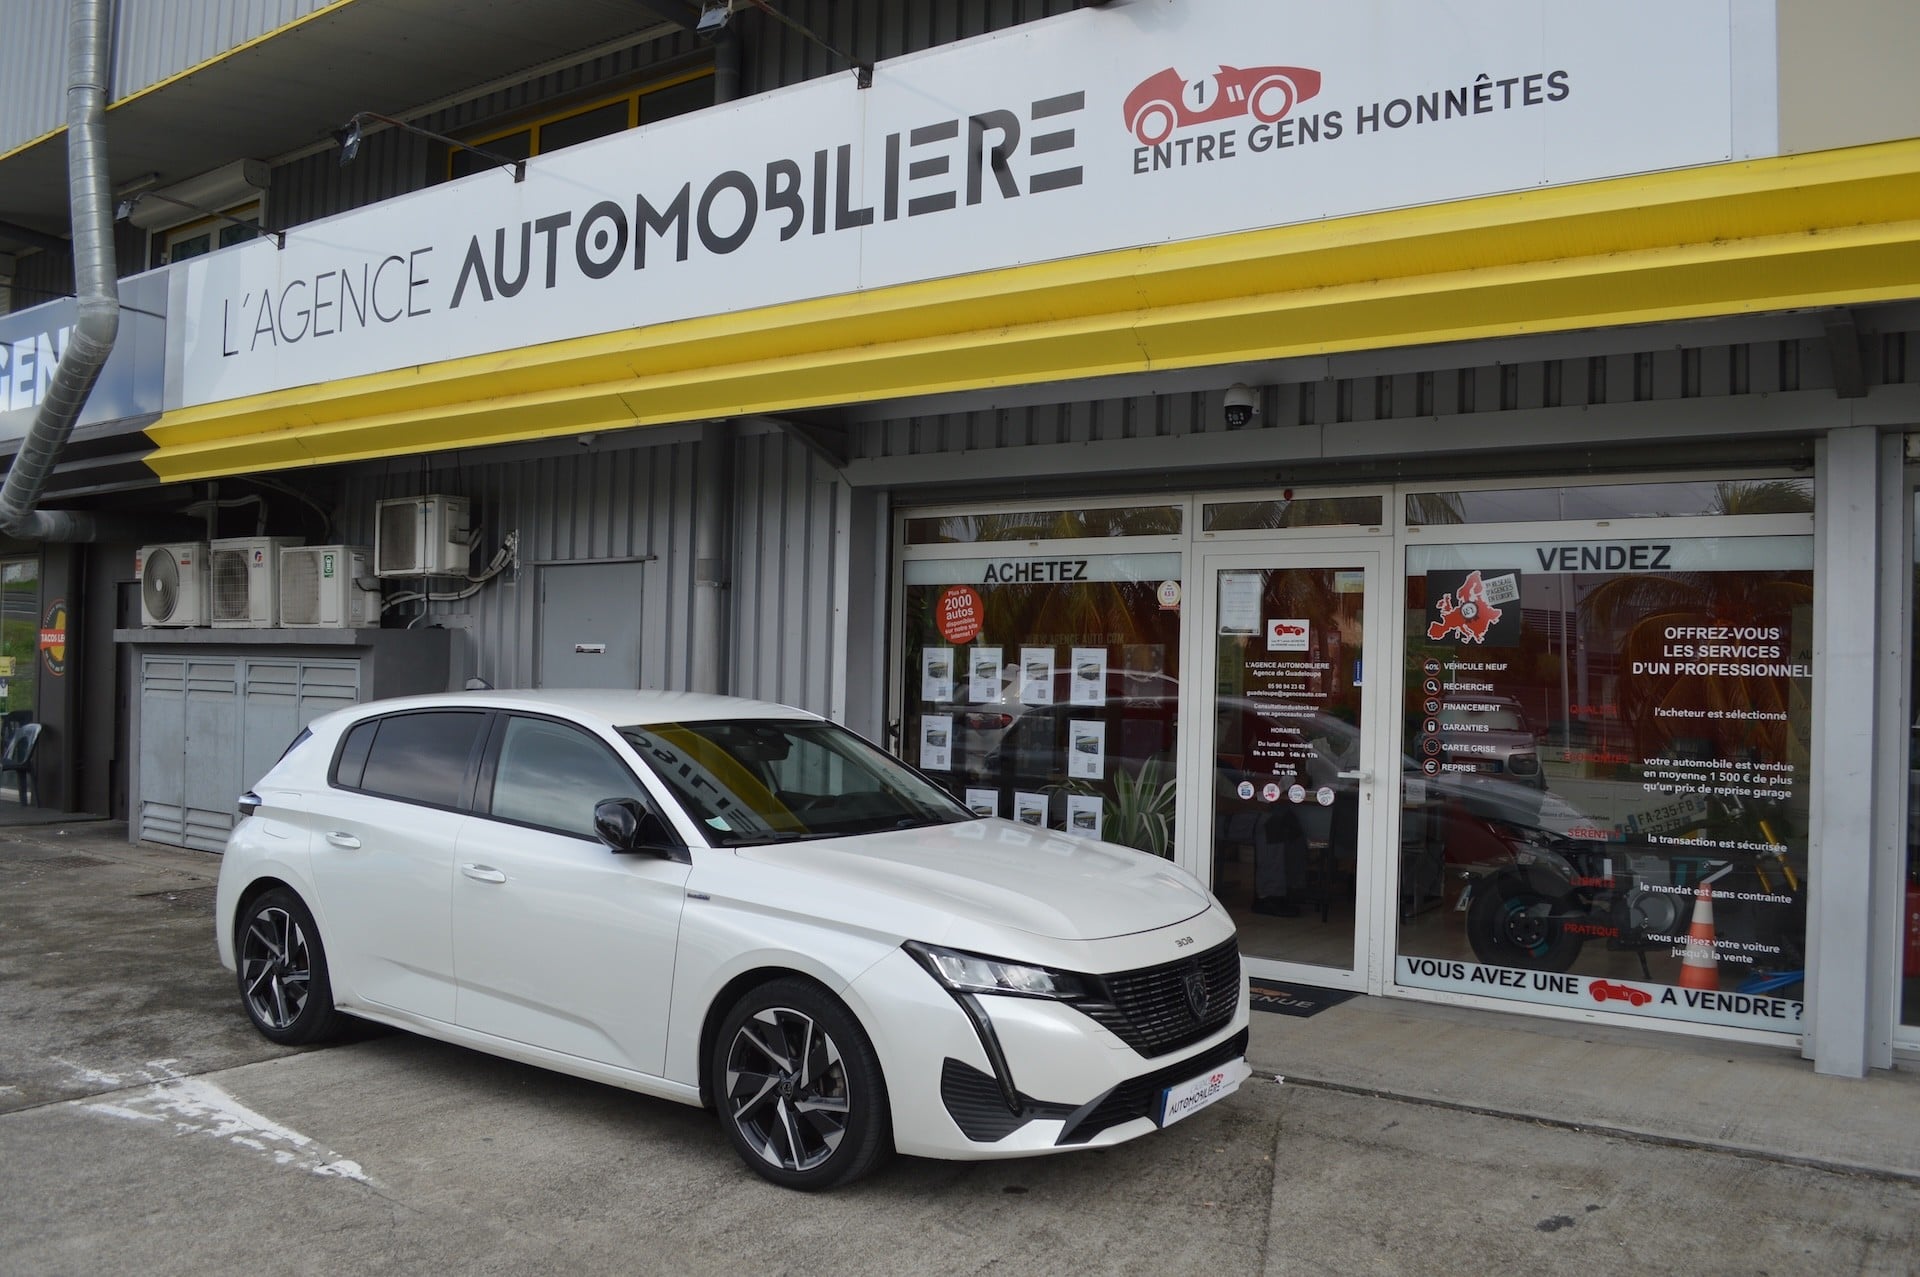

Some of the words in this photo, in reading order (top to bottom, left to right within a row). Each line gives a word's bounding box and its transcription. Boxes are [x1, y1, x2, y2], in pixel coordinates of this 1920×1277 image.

[1193, 80, 1205, 104] 1
[1133, 129, 1236, 174] ENTRE
[1248, 111, 1343, 153] GENS
[1357, 70, 1570, 135] HONNÊTES
[223, 246, 433, 357] L'AGENCE
[449, 90, 1086, 309] AUTOMOBILIERE
[1537, 545, 1671, 571] VENDEZ
[984, 560, 1087, 582] ACHETEZ
[944, 594, 972, 611] 2000
[946, 608, 974, 620] autos
[1664, 627, 1780, 640] OFFREZ-VOUS
[1664, 645, 1694, 658] LES
[1697, 646, 1780, 658] SERVICES
[1278, 662, 1330, 670] AUTOMOBILIERE
[1285, 670, 1322, 678] Guadeloupe
[1632, 662, 1670, 675] D'UN
[1674, 663, 1812, 678] PROFESSIONNEL
[1443, 682, 1494, 692] RECHERCHE
[1442, 703, 1501, 712] FINANCEMENT
[1654, 707, 1704, 720] l'acheteur
[1707, 709, 1724, 720] est
[1726, 708, 1788, 721] sélectionné
[1442, 723, 1490, 732] GARANTIES
[1442, 744, 1469, 752] CARTE
[1471, 744, 1496, 752] GRISE
[1442, 764, 1476, 772] REPRISE
[1643, 758, 1669, 767] votre
[1672, 758, 1733, 770] automobile
[1735, 761, 1752, 771] est
[1753, 760, 1794, 772] vendue
[1644, 770, 1656, 778] en
[1659, 771, 1706, 784] moyenne
[1710, 772, 1716, 782] 1
[1719, 773, 1740, 783] 500
[1743, 774, 1751, 784] €
[1752, 774, 1767, 784] de
[1770, 775, 1793, 788] plus
[1643, 782, 1672, 794] qu'un
[1674, 782, 1696, 796] prix
[1698, 784, 1712, 794] de
[1714, 784, 1750, 798] reprise
[1753, 786, 1792, 800] garage
[1648, 833, 1658, 843] la
[1660, 836, 1716, 848] transaction
[1719, 840, 1735, 848] est
[1737, 839, 1788, 852] sécurisée
[1640, 882, 1650, 892] le
[1652, 884, 1691, 896] mandat
[1694, 886, 1710, 896] est
[1712, 888, 1735, 898] sans
[1737, 889, 1792, 904] contrainte
[1564, 922, 1620, 938] PRATIQUE
[1174, 936, 1194, 948] 308
[1648, 933, 1672, 943] vous
[1674, 934, 1710, 946] utilisez
[1712, 938, 1740, 949] votre
[1742, 940, 1780, 954] voiture
[1671, 946, 1709, 960] jusqu'à
[1712, 950, 1720, 960] la
[1723, 953, 1753, 964] vente
[1408, 958, 1464, 980] VOUS
[1470, 966, 1526, 988] AVEZ
[1534, 974, 1578, 994] UNE
[1660, 988, 1678, 1006] A
